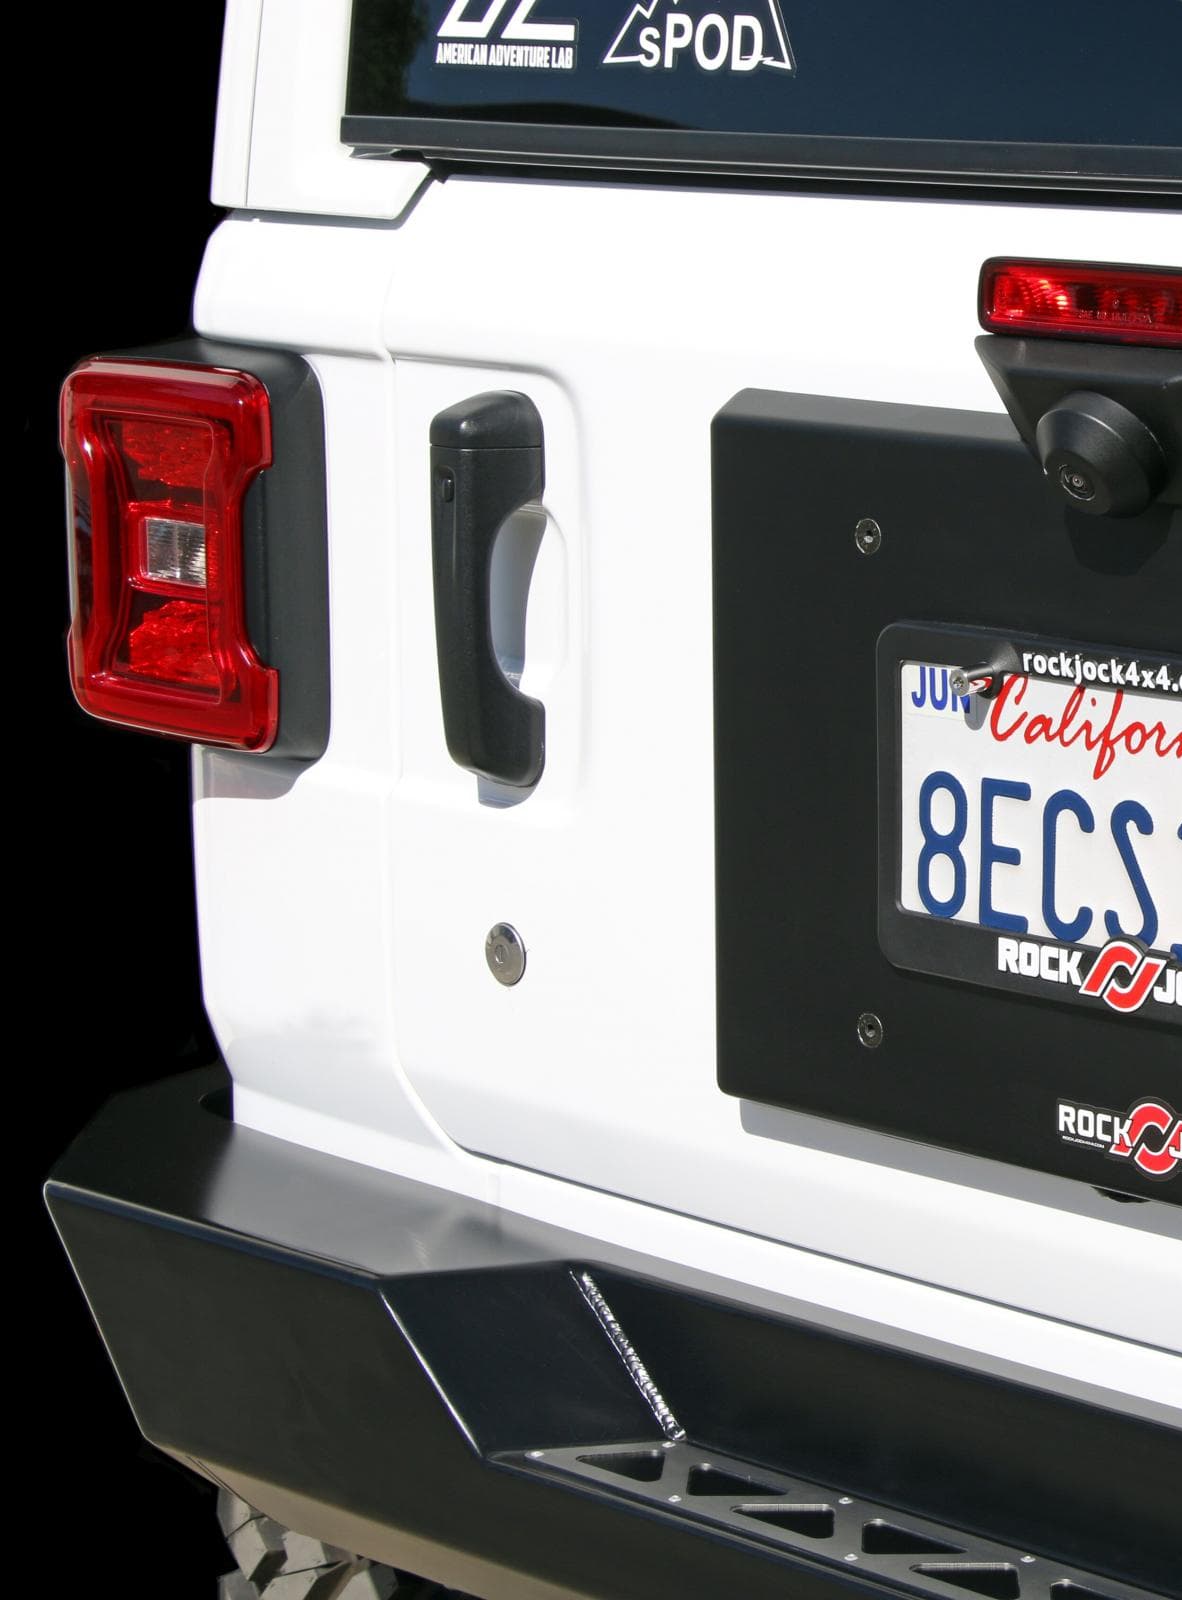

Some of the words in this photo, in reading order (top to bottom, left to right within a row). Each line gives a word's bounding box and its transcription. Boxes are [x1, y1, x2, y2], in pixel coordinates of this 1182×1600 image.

[436, 43, 488, 65] AMERICAN
[488, 44, 551, 68] ADVENTURE
[551, 47, 574, 69] LAB
[638, 12, 763, 71] sPOD
[997, 937, 1084, 986] ROCK
[1058, 1104, 1133, 1148] ROCK
